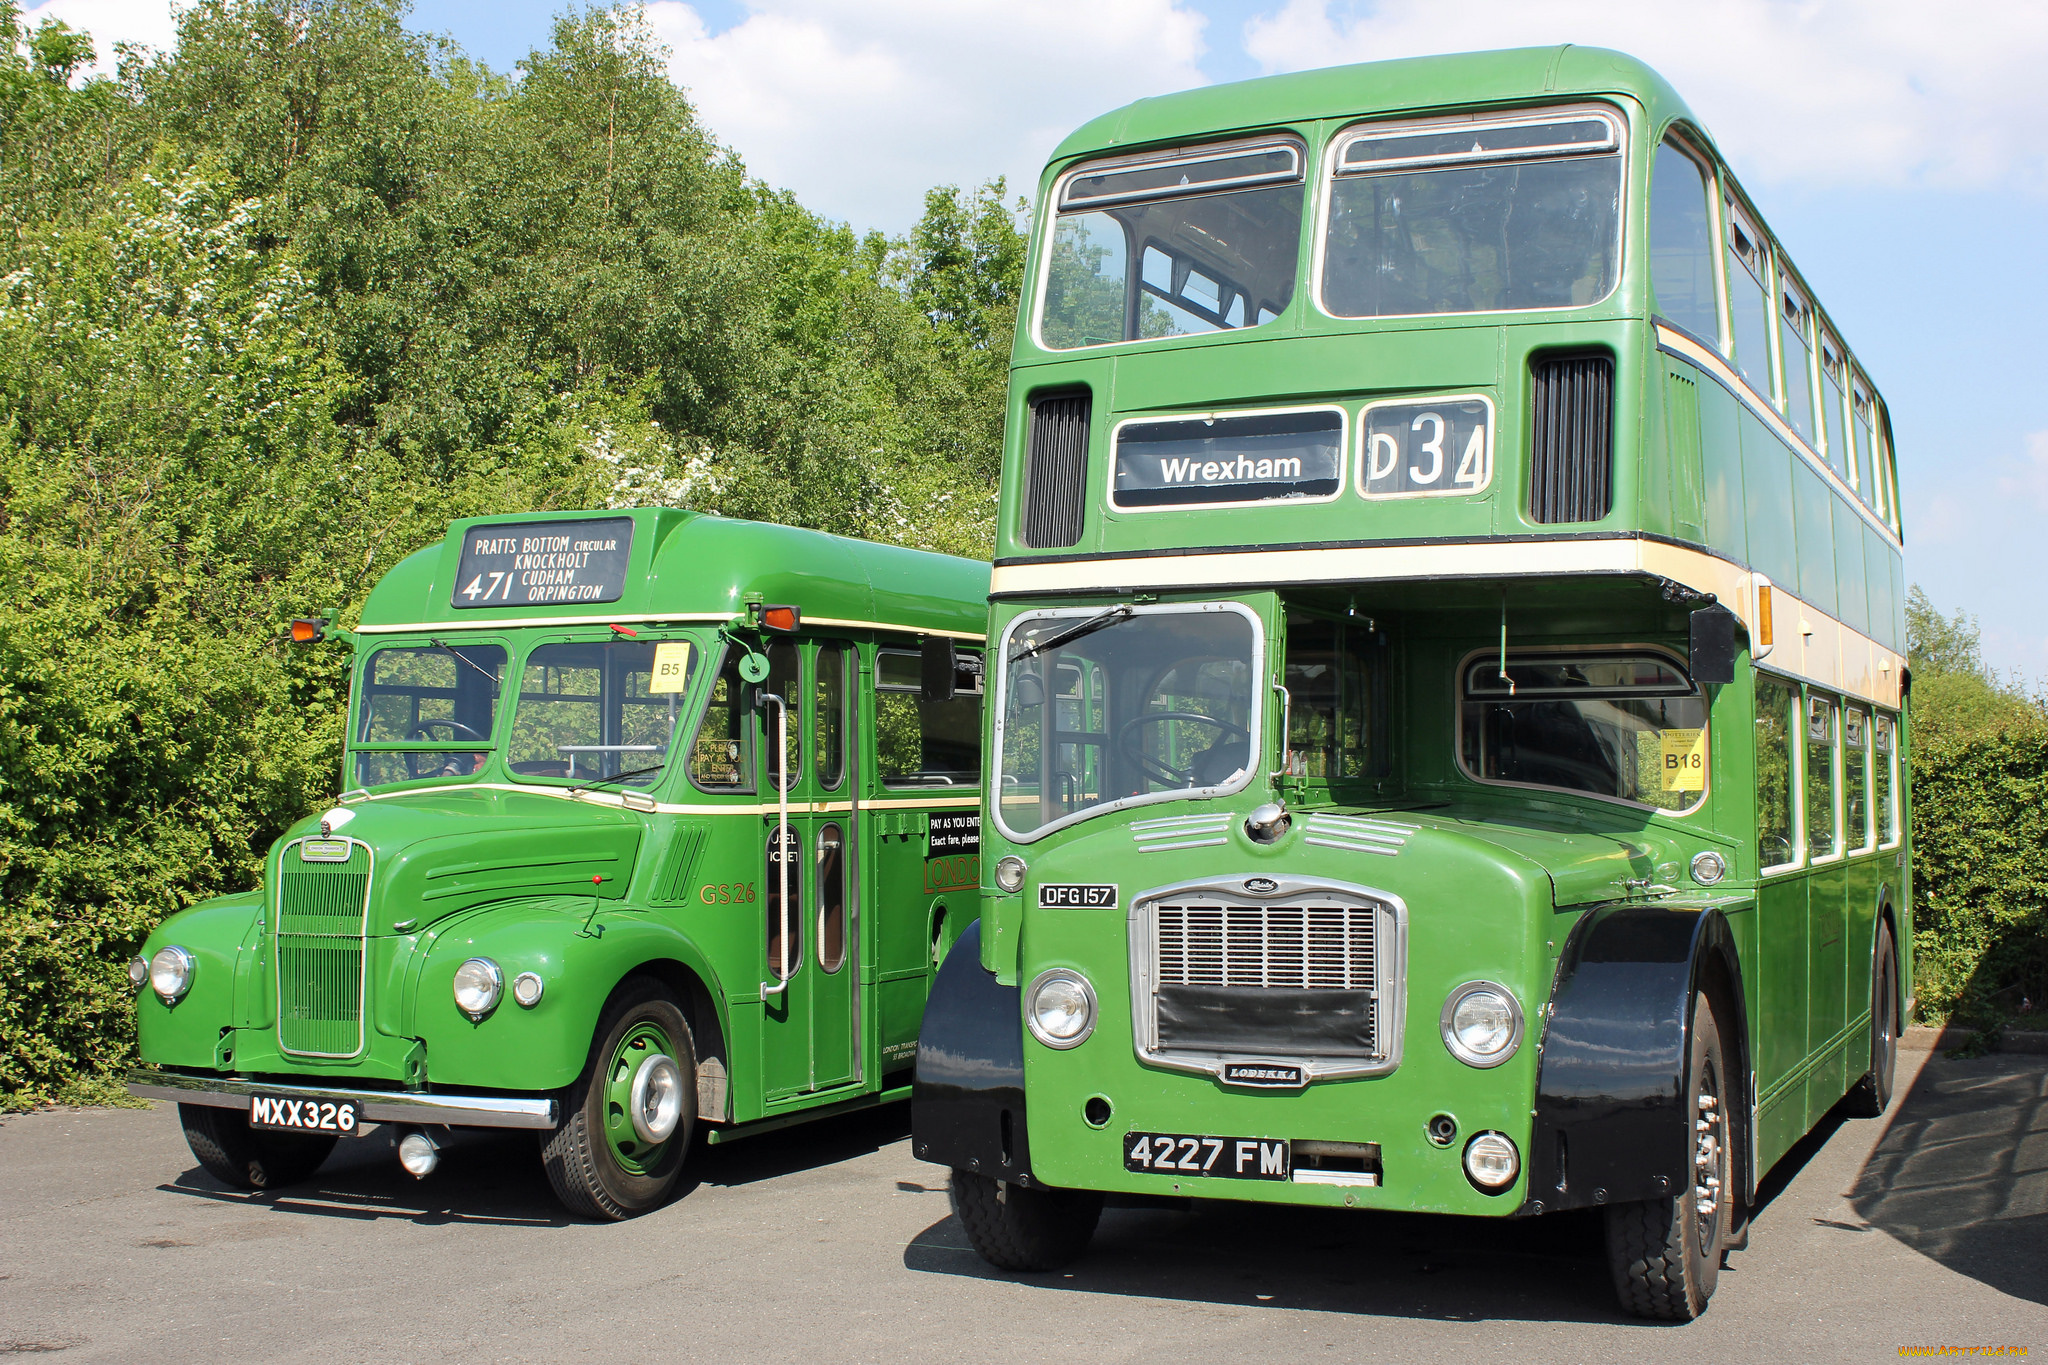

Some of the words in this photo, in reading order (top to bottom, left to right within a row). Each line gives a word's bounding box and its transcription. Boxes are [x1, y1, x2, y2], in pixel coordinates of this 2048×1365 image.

[1160, 454, 1301, 483] Wrexham
[475, 538, 517, 555] PRATTS
[522, 536, 570, 553] BOTTOM
[574, 540, 616, 552] CIRCULAR
[514, 552, 590, 570] KNOCKHOLT
[462, 572, 514, 600] 471
[522, 570, 575, 586] CUDHAM
[528, 585, 604, 601] ORPINGTON
[660, 663, 680, 675] B5
[1665, 753, 1701, 769] B18
[930, 819, 942, 829] PAY
[943, 818, 951, 828] AS
[952, 817, 965, 828] YOU
[931, 835, 946, 846] Exact
[947, 834, 960, 845] fare,
[961, 833, 979, 847] please
[1046, 887, 1080, 904] DFG
[1082, 887, 1111, 904] 157
[1230, 1068, 1297, 1080] LODEKKA
[252, 1096, 356, 1131] MXX326
[1130, 1135, 1224, 1171] 4227
[1236, 1141, 1284, 1176] FM
